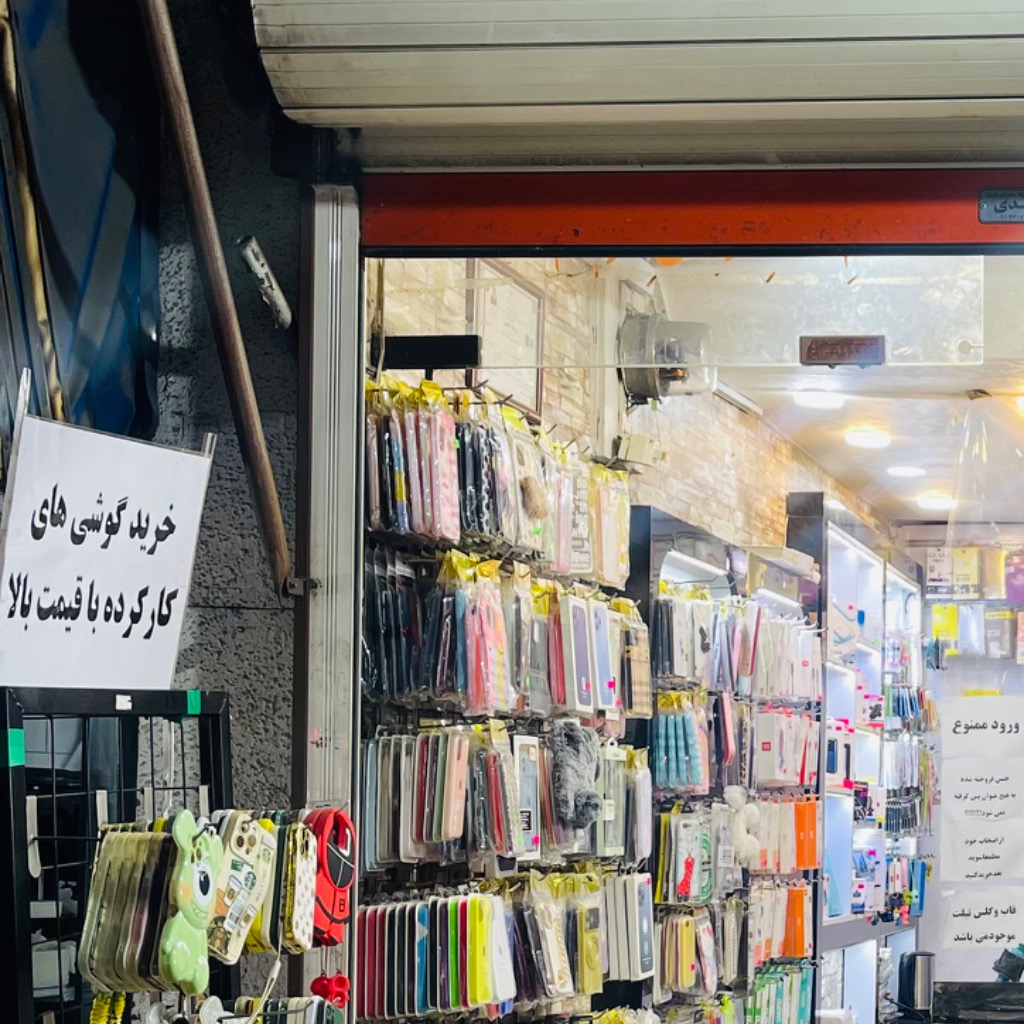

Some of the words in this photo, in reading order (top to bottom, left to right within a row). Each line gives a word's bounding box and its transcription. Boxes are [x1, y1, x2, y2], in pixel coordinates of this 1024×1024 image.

[31, 483, 66, 540] های
[71, 492, 128, 549] گوشی
[130, 504, 176, 555] خرید
[7, 572, 32, 631] بالا
[37, 575, 83, 632] قیمت
[87, 580, 100, 634] با
[952, 720, 988, 734] ممنوع
[991, 720, 1020, 734] ورود
